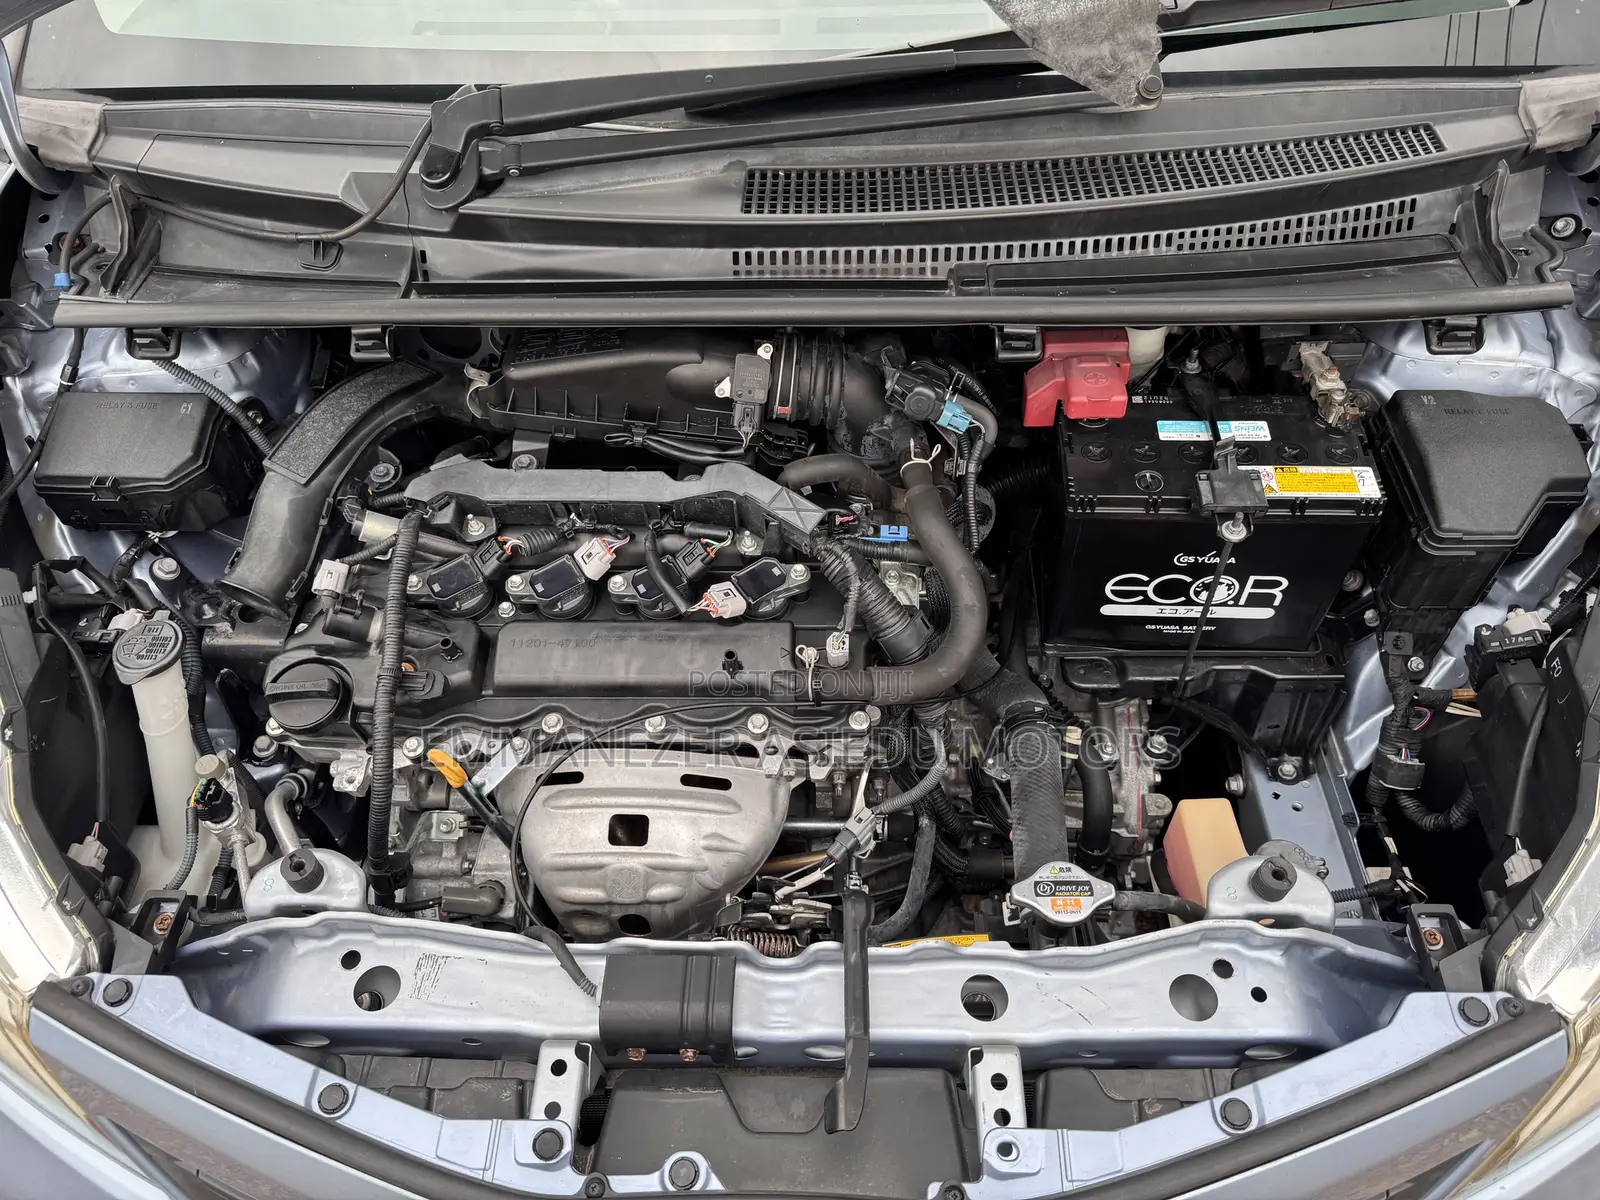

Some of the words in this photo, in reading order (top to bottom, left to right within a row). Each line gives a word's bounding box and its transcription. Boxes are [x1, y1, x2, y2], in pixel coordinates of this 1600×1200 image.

[97, 401, 126, 409] RELAY
[1443, 407, 1475, 415] RELAY
[1077, 885, 1091, 893] JOY
